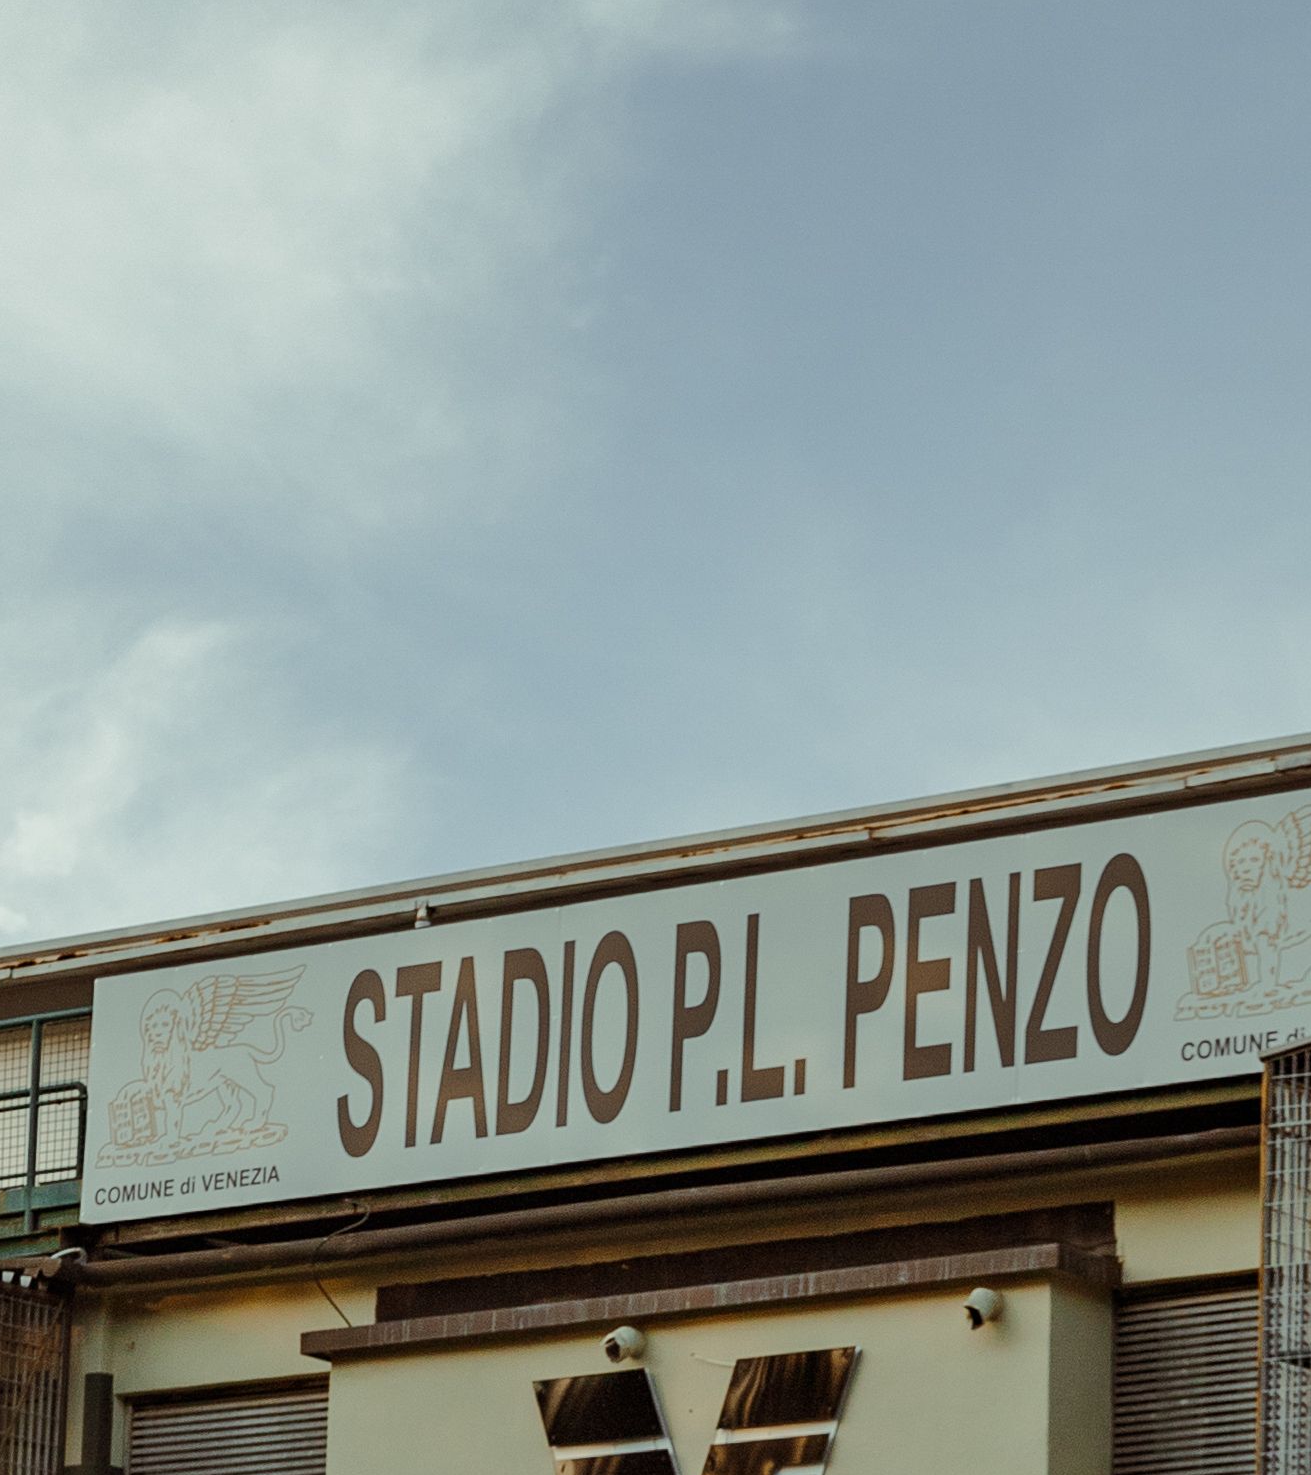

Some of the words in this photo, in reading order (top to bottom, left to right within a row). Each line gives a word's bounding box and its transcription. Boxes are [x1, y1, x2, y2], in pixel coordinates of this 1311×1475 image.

[337, 930, 639, 1158] STADIO
[669, 912, 807, 1112] P.L.
[843, 852, 1151, 1089] PENZO
[1181, 1030, 1278, 1062] COMUNE
[94, 1178, 175, 1206] COMUNE
[179, 1175, 196, 1196] di
[201, 1165, 281, 1192] VENEZIA
